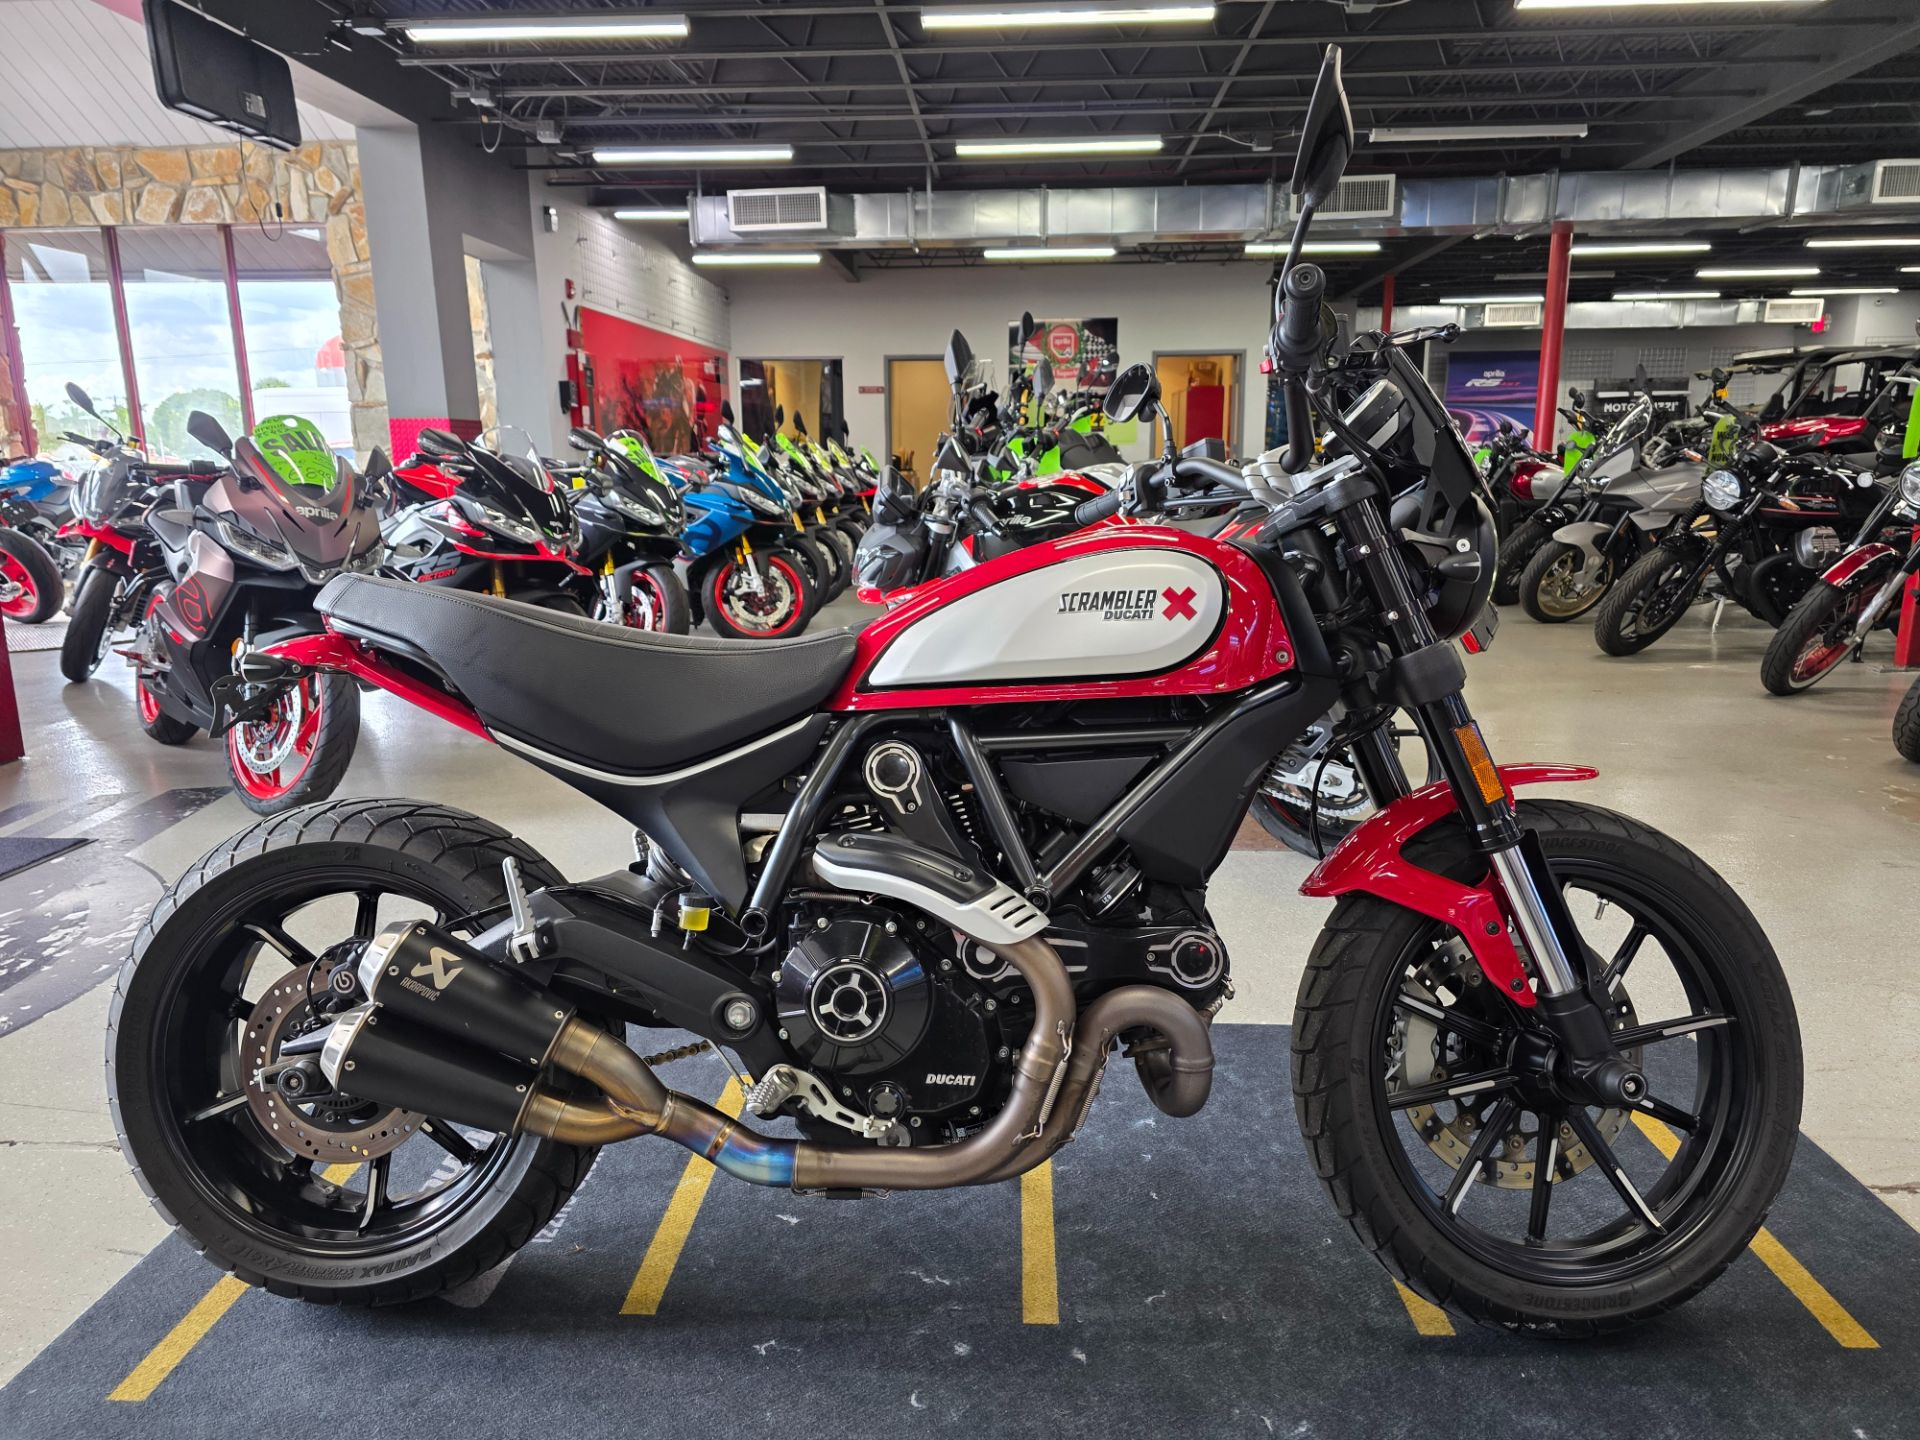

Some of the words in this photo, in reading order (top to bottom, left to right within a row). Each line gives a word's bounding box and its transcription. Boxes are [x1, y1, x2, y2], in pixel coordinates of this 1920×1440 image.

[1483, 369, 1505, 378] aprilia
[296, 506, 338, 521] aprilia
[411, 551, 461, 578] RS
[1058, 589, 1158, 613] SCRAMBLER
[1103, 609, 1154, 620] DUCATI
[925, 1073, 976, 1086] DUCATI
[1522, 1291, 1633, 1313] BRIDGESTONE
